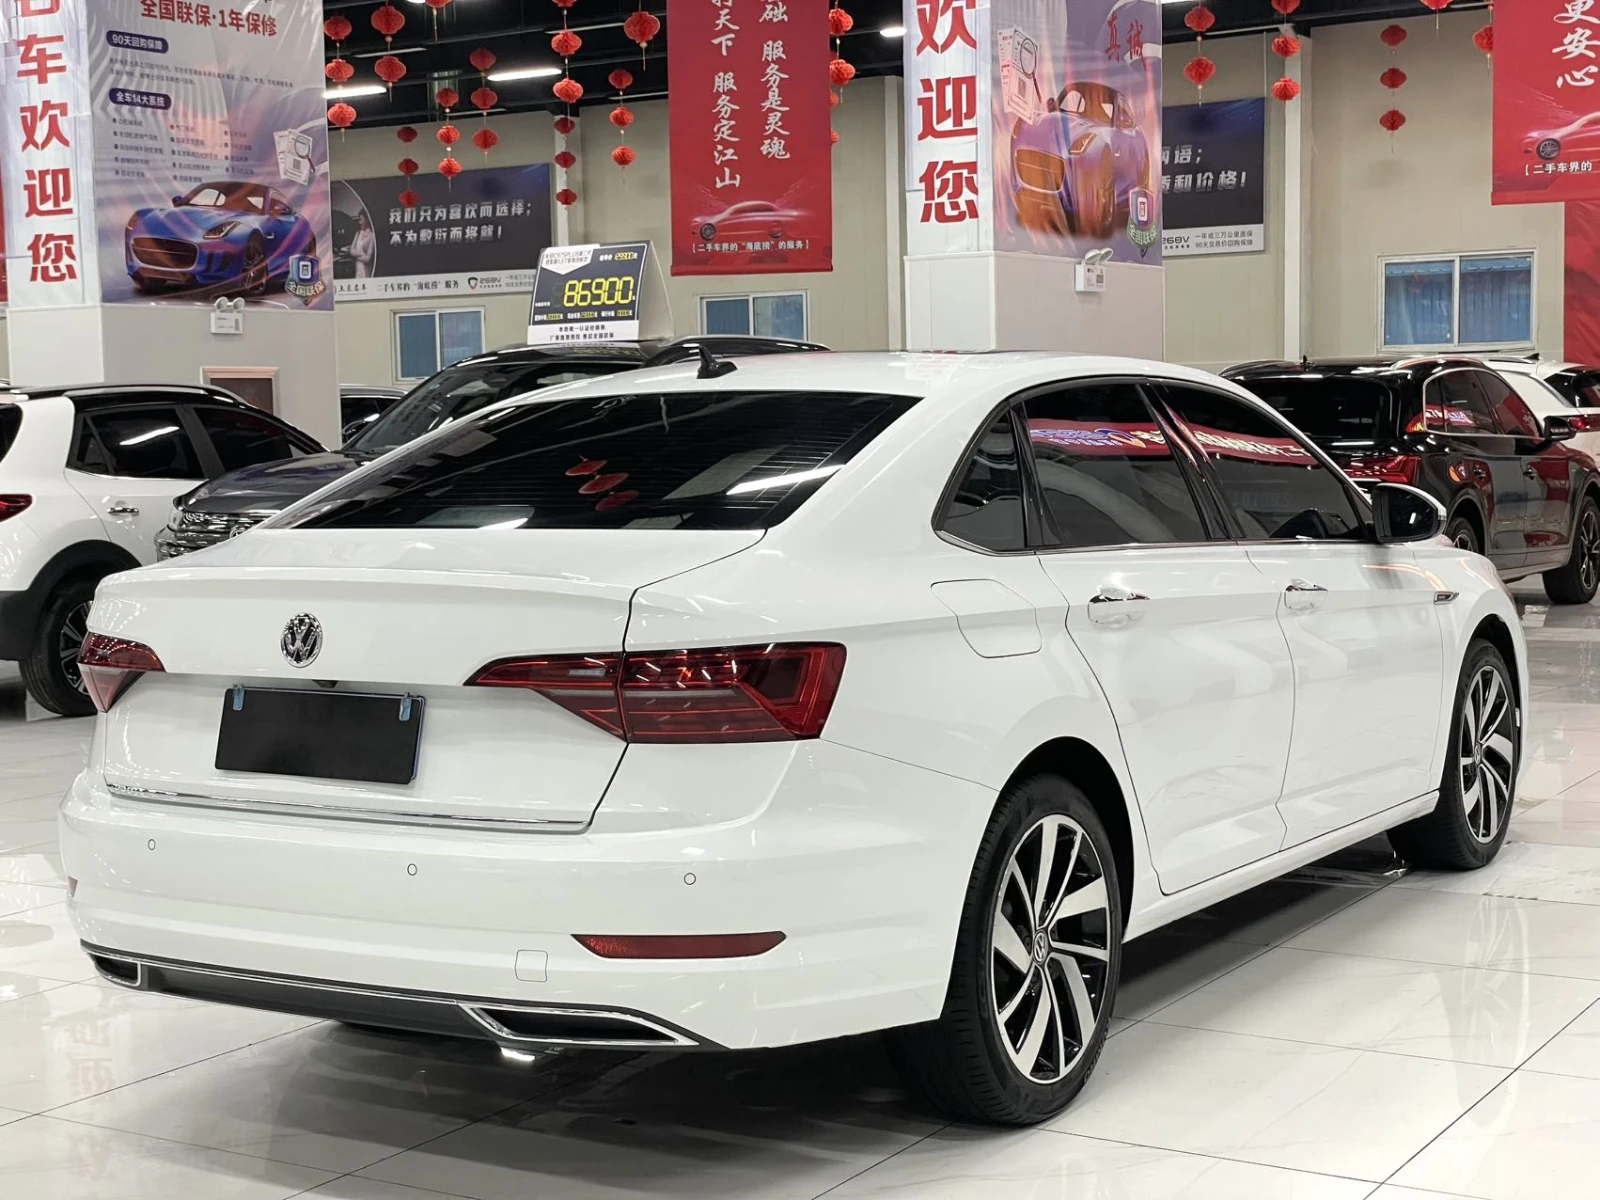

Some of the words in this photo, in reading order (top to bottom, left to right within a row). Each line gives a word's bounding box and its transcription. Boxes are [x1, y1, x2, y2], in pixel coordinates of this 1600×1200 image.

[112, 34, 163, 50] 90天回购保障
[759, 0, 788, 23] 础
[1552, 0, 1600, 88] 更安心
[712, 71, 741, 189] 服务定江山
[760, 40, 791, 160] 服务是灵魂
[916, 0, 979, 223] 欢迎您
[563, 276, 634, 307] 86900
